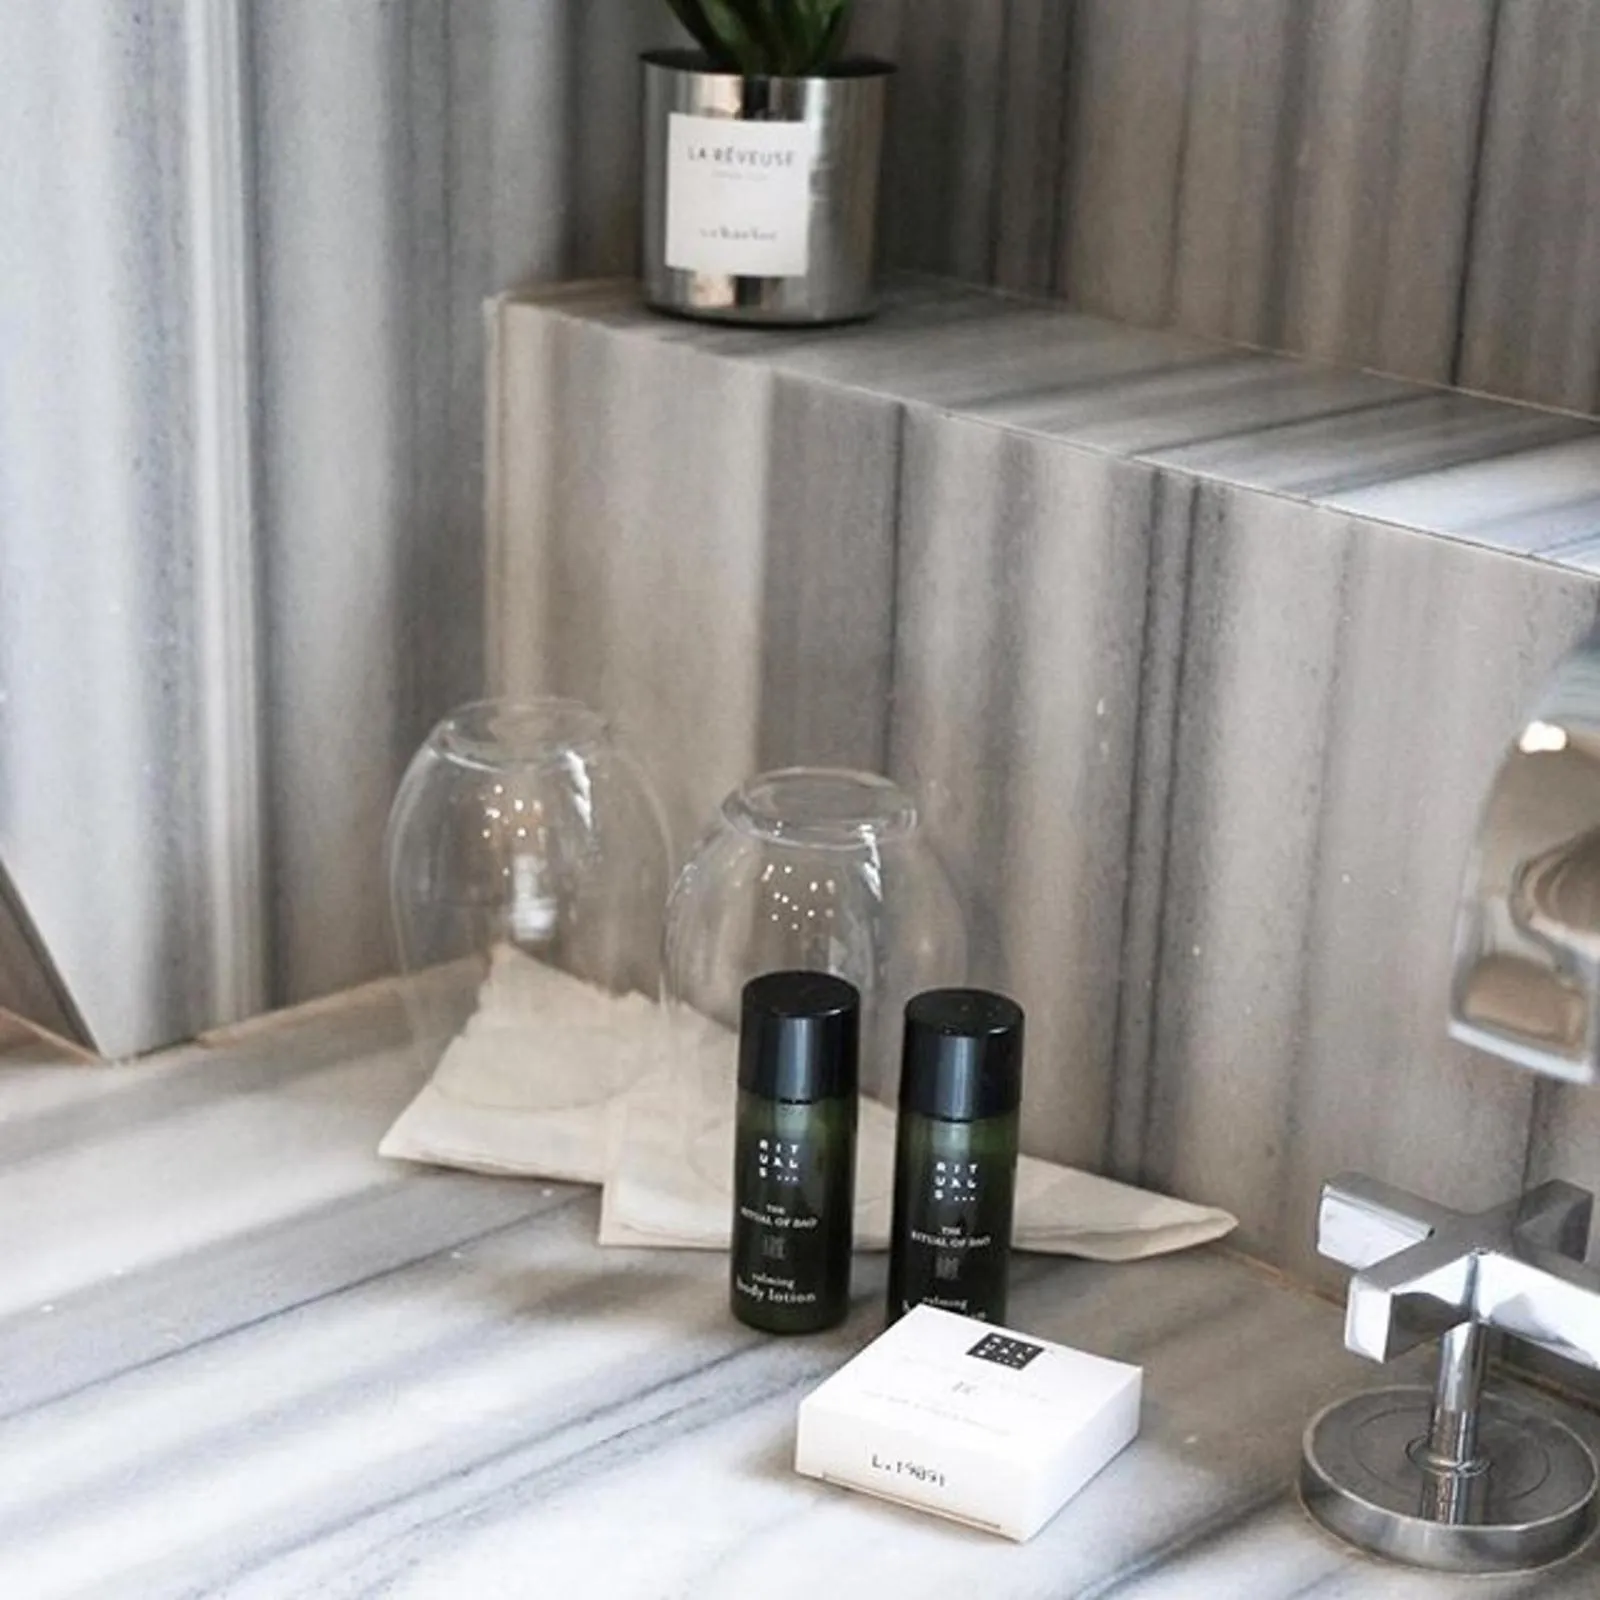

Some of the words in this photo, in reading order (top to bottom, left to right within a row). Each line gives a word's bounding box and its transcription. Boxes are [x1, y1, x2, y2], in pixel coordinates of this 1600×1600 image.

[687, 147, 706, 161] LA
[774, 1216, 791, 1228] OF
[949, 1238, 966, 1249] OF
[768, 1288, 816, 1304] lotion
